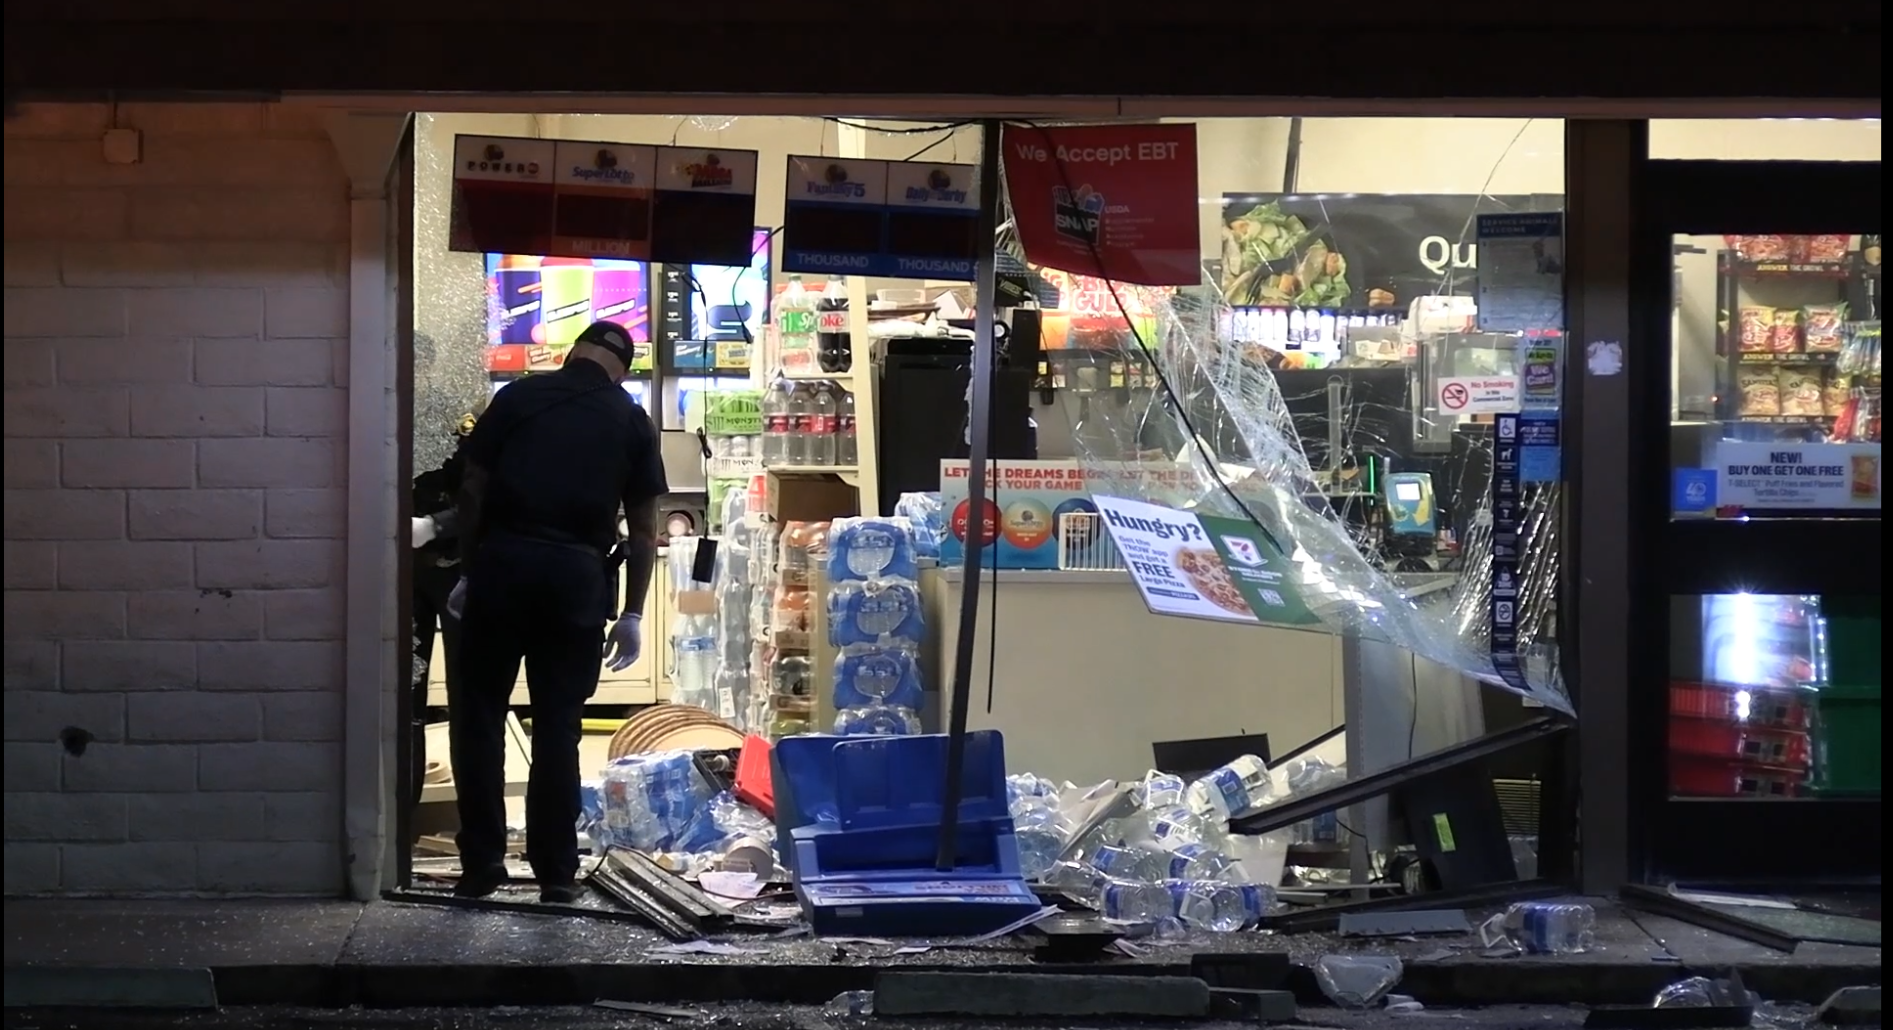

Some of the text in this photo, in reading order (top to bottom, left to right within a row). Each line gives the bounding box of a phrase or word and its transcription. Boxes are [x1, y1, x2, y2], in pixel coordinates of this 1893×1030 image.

[1016, 142, 1178, 166] We Accept EBT
[1104, 205, 1130, 214] USDA
[1056, 213, 1099, 232] SNAP
[572, 240, 630, 255] MILLION
[797, 253, 869, 268] THOUSAND
[898, 258, 970, 273] THOUSAND
[1483, 381, 1514, 390] Smoking
[1770, 452, 1802, 464] NEW!
[945, 467, 969, 478] LET
[1005, 468, 1064, 479] DREAMS
[1728, 465, 1844, 476] BUY ONE GET ONE FREE
[1006, 480, 1041, 489] YOUR
[1044, 480, 1082, 491] GAME
[1104, 508, 1203, 542] Hungry?
[1118, 535, 1151, 547] Get the
[1127, 552, 1145, 560] and
[1145, 555, 1160, 563] get
[1152, 549, 1169, 558] app
[1132, 560, 1176, 579] FREE
[1139, 575, 1186, 589] Large Pizza
